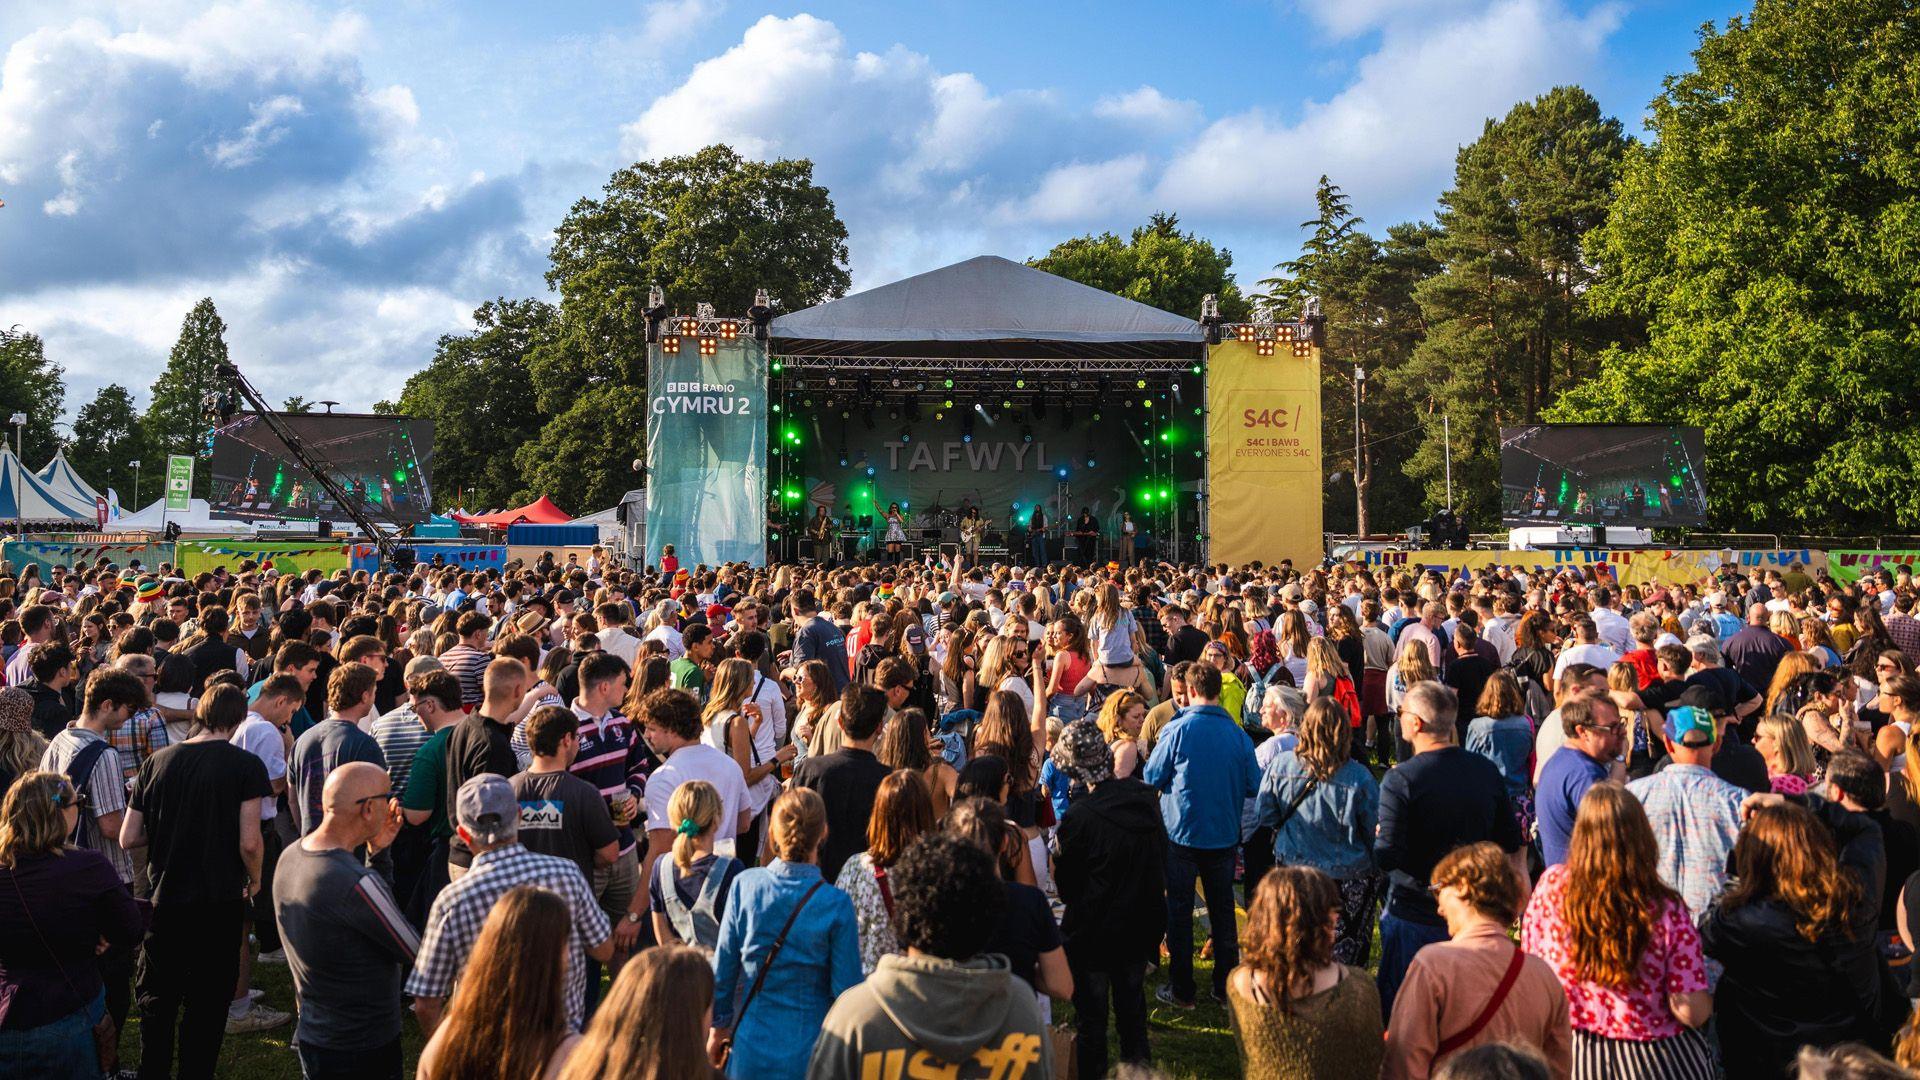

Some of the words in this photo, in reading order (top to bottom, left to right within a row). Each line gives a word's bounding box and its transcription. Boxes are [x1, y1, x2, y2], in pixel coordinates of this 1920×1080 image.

[702, 384, 735, 392] RADIO
[652, 396, 734, 415] CYMRU
[738, 397, 750, 415] 2
[1243, 408, 1288, 428] S4C
[1246, 438, 1265, 446] S4C
[1272, 438, 1300, 447] BAWB
[883, 441, 1054, 472] TAFWYL
[1235, 448, 1291, 457] EVERYONE'S
[1293, 449, 1311, 457] S4C
